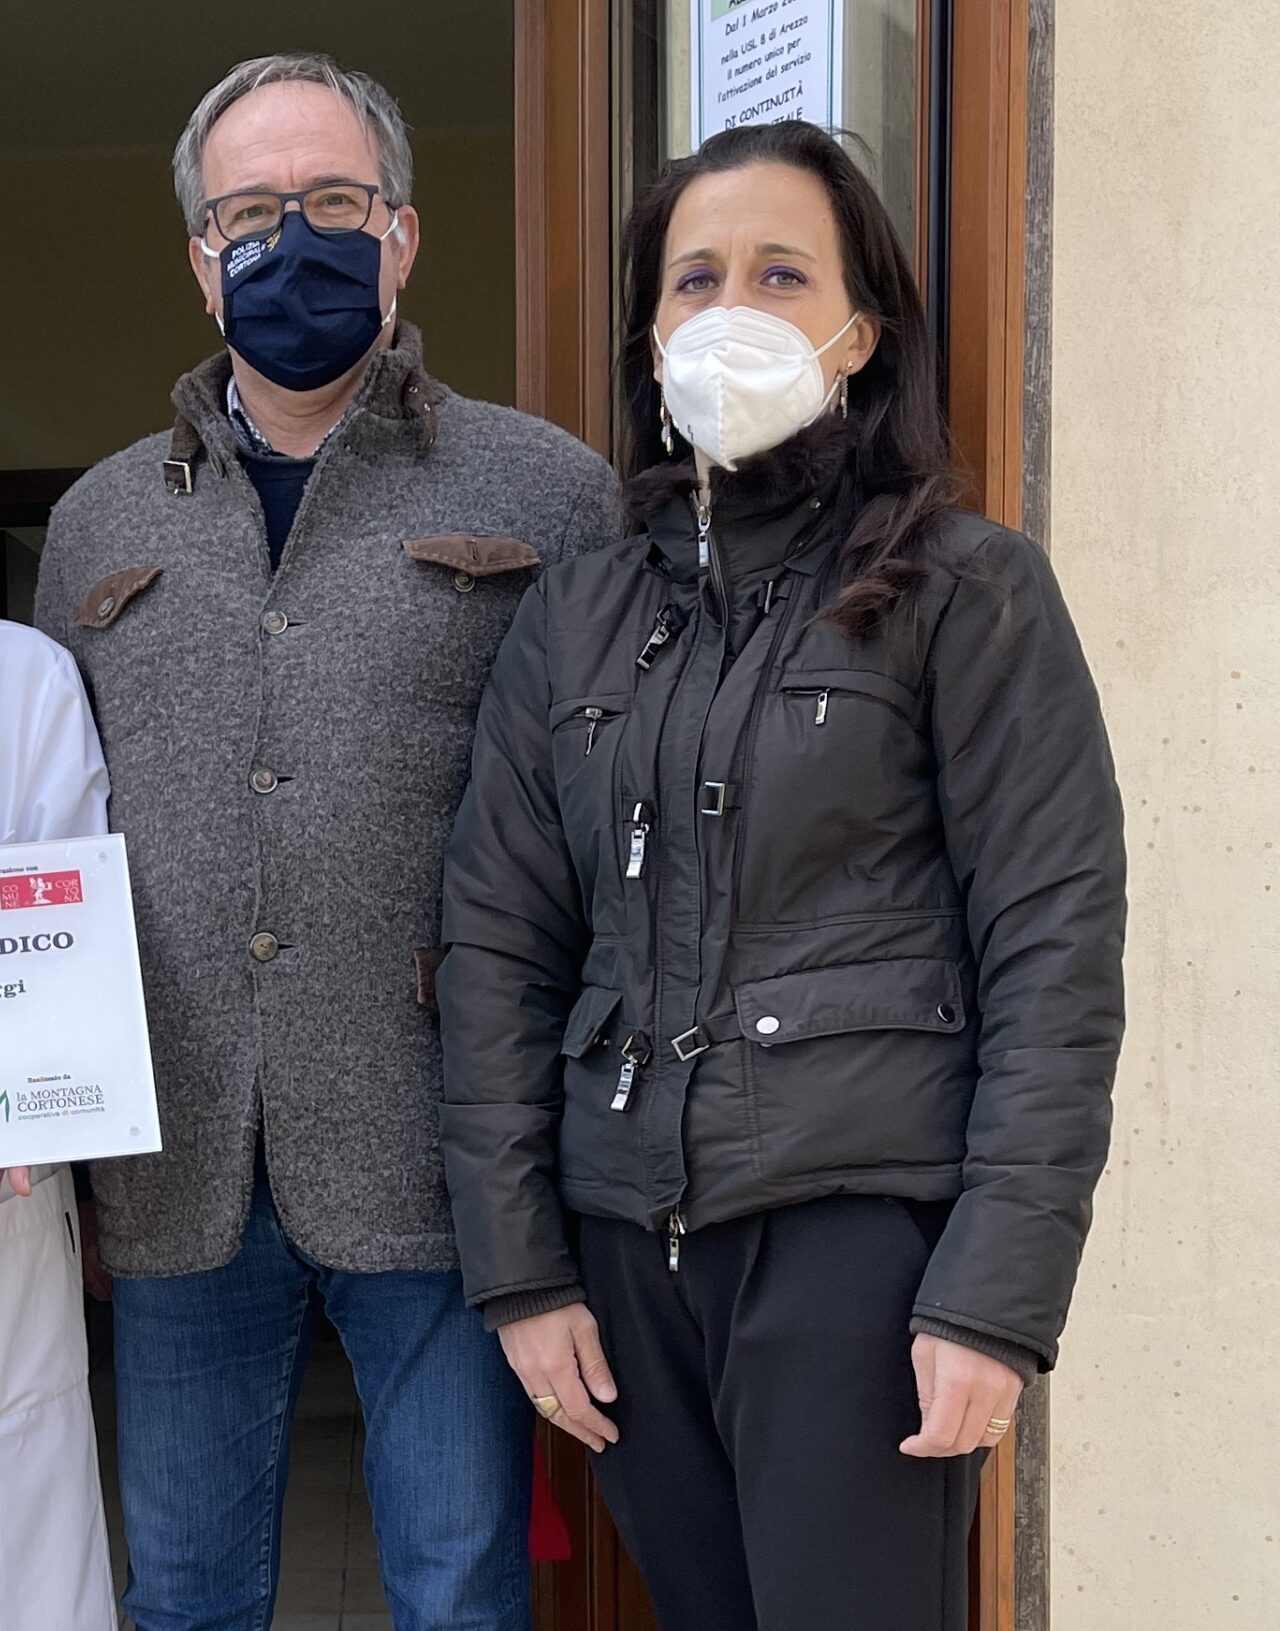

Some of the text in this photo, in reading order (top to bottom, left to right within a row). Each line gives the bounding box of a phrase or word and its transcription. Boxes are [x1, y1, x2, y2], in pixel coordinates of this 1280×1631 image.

[725, 17, 739, 36] Dal
[750, 2, 779, 23] Marzo
[720, 15, 808, 65] nella USL 8 di Arezzo
[734, 58, 762, 77] numero
[764, 48, 785, 63] unico
[787, 37, 802, 55] per
[765, 65, 778, 80] del
[780, 51, 812, 74] servizio
[724, 115, 737, 130] DI
[739, 80, 804, 124] CONTINUITÀ
[54, 878, 79, 888] COR
[16, 1084, 103, 1102] la MONTAGNA
[17, 1093, 105, 1113] CORTONESE
